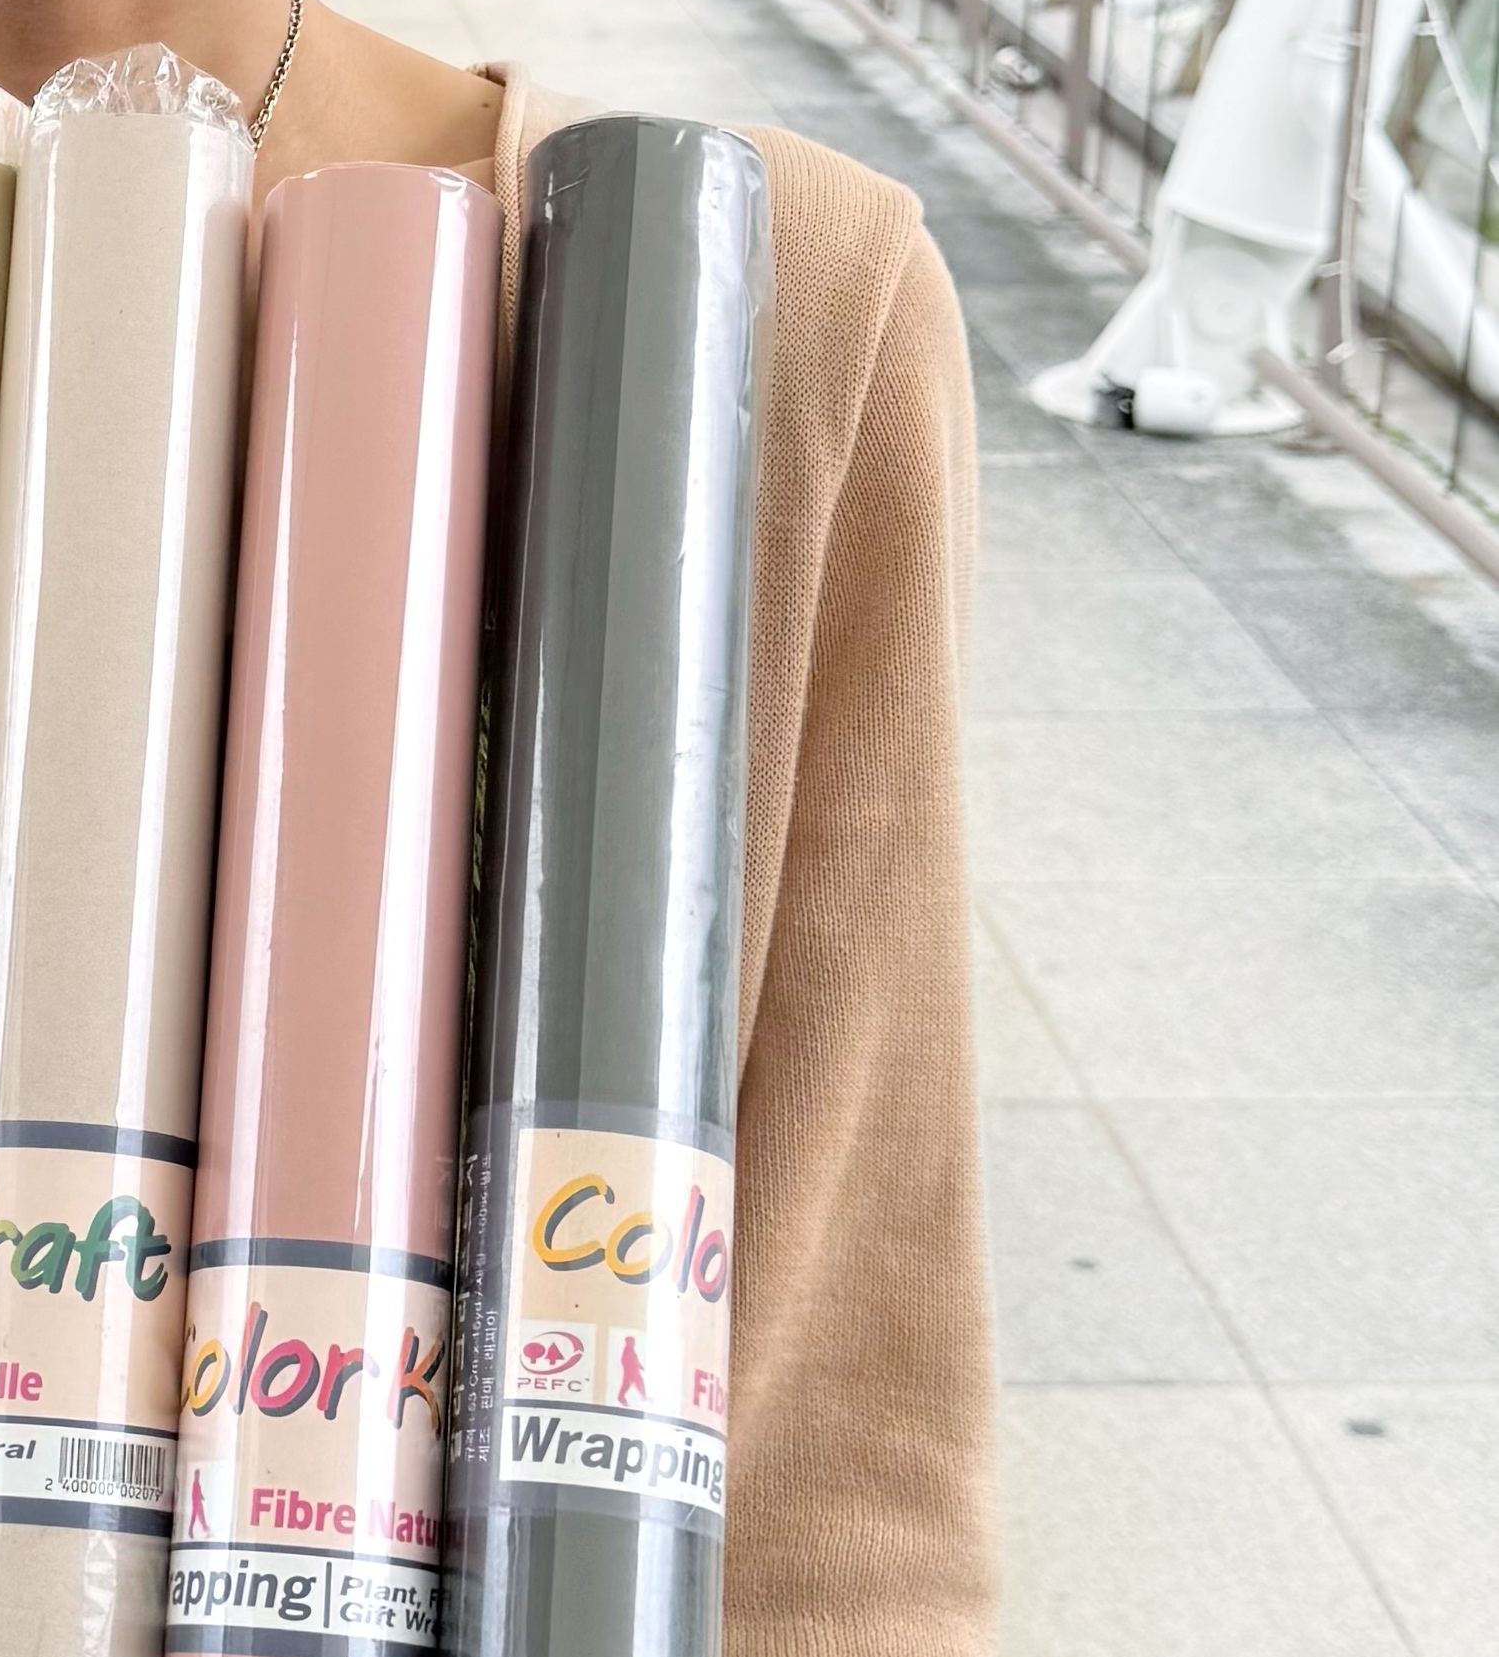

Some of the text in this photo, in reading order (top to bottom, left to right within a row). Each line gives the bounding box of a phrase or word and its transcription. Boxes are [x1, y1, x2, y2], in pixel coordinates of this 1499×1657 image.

[532, 1173, 727, 1304] Colo
[181, 1301, 380, 1421] olor
[516, 1377, 583, 1392] PEFC
[511, 1415, 723, 1505] Wrapping
[250, 1487, 356, 1535] Fibre
[169, 1560, 316, 1621] apping
[340, 1575, 421, 1611] Plant,
[340, 1602, 396, 1628] Gift
